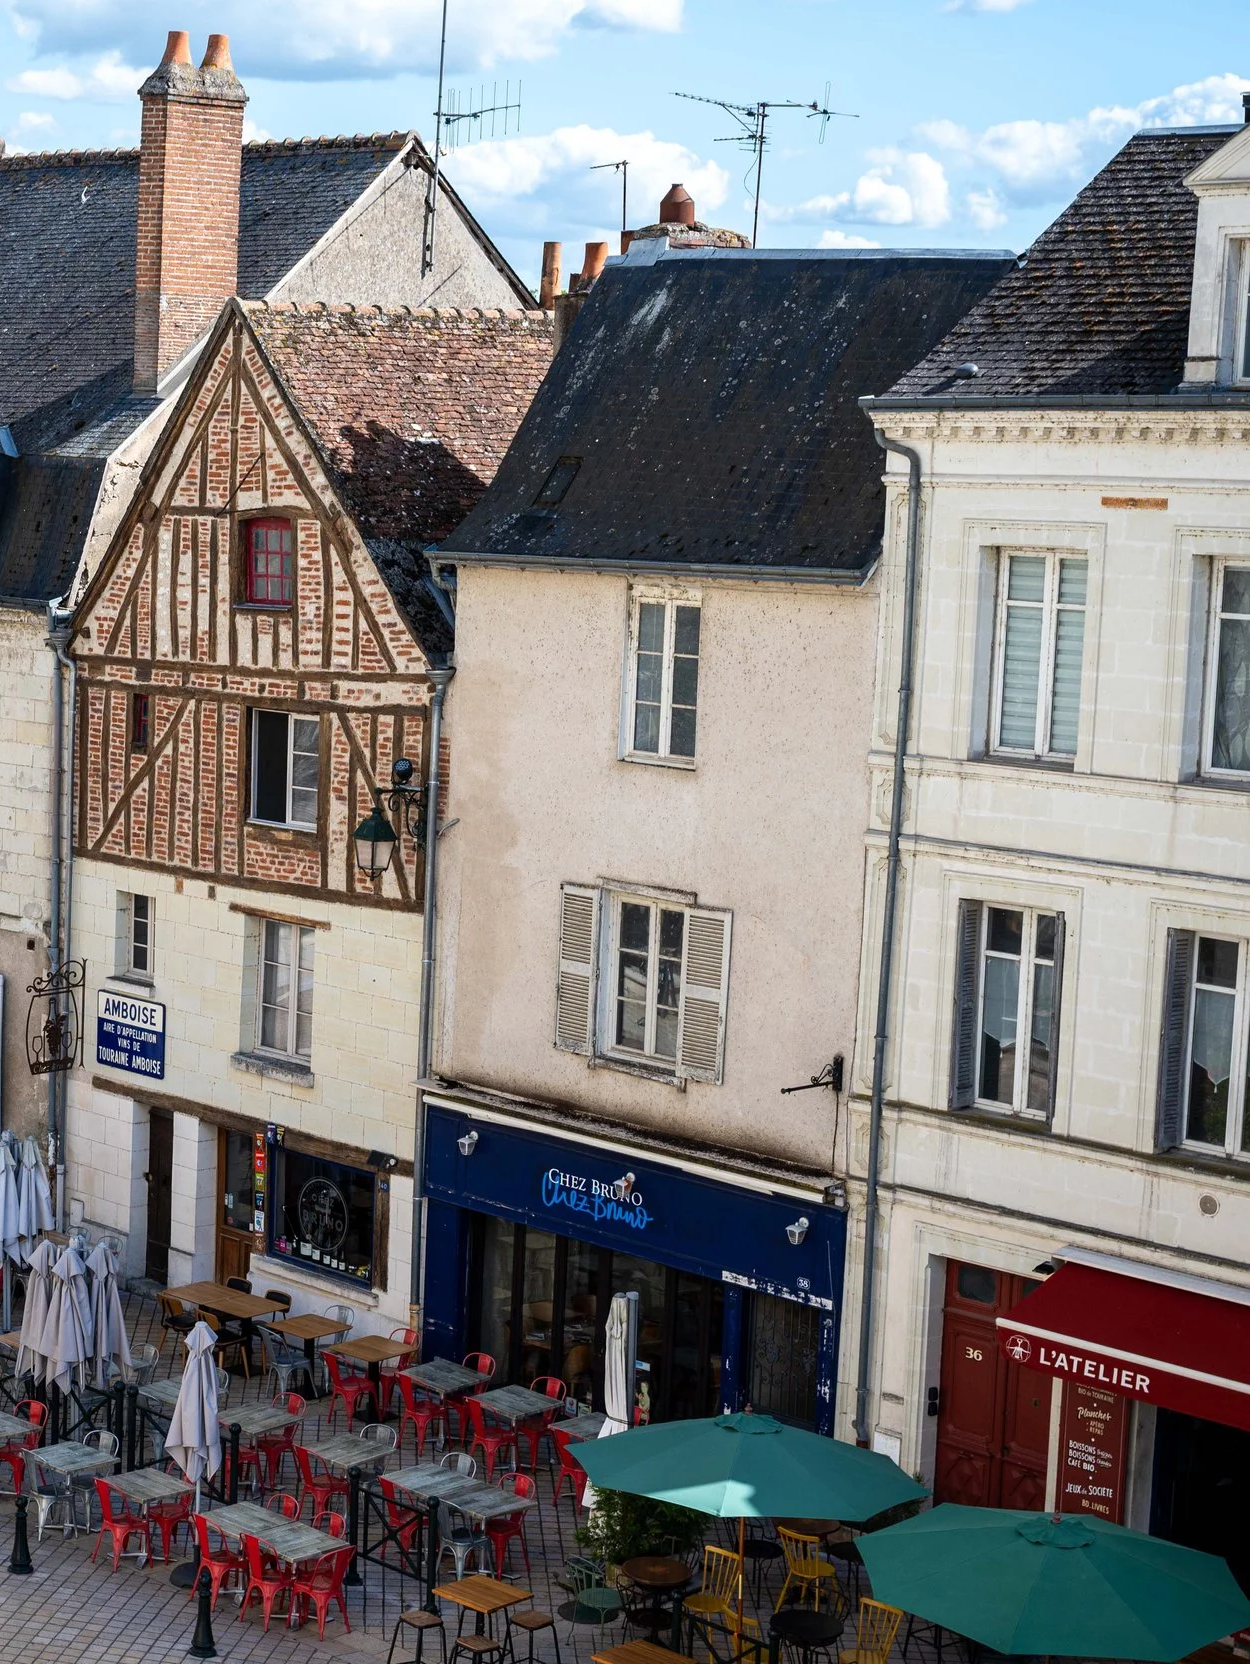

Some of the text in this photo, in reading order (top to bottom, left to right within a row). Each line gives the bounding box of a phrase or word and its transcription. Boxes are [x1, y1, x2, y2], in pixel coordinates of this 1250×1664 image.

[104, 997, 157, 1026] AMBOISE
[103, 1021, 157, 1044] AIRE D'APPELLATION
[118, 1038, 140, 1052] VINS DE
[99, 1046, 161, 1075] TOURAINE AMBOISE
[549, 1168, 587, 1191] CHEZ
[542, 1172, 590, 1211] Chez
[302, 1209, 343, 1232] BRUNO
[799, 1279, 808, 1288] 38
[965, 1347, 982, 1361] 36
[1039, 1347, 1150, 1393] L'ATELIER
[1077, 1406, 1112, 1420] Planches
[1069, 1440, 1096, 1455] BOISSONS
[1069, 1449, 1096, 1464] BOISSONS
[1082, 1462, 1095, 1472] BIO
[1065, 1482, 1081, 1494] JEUX
